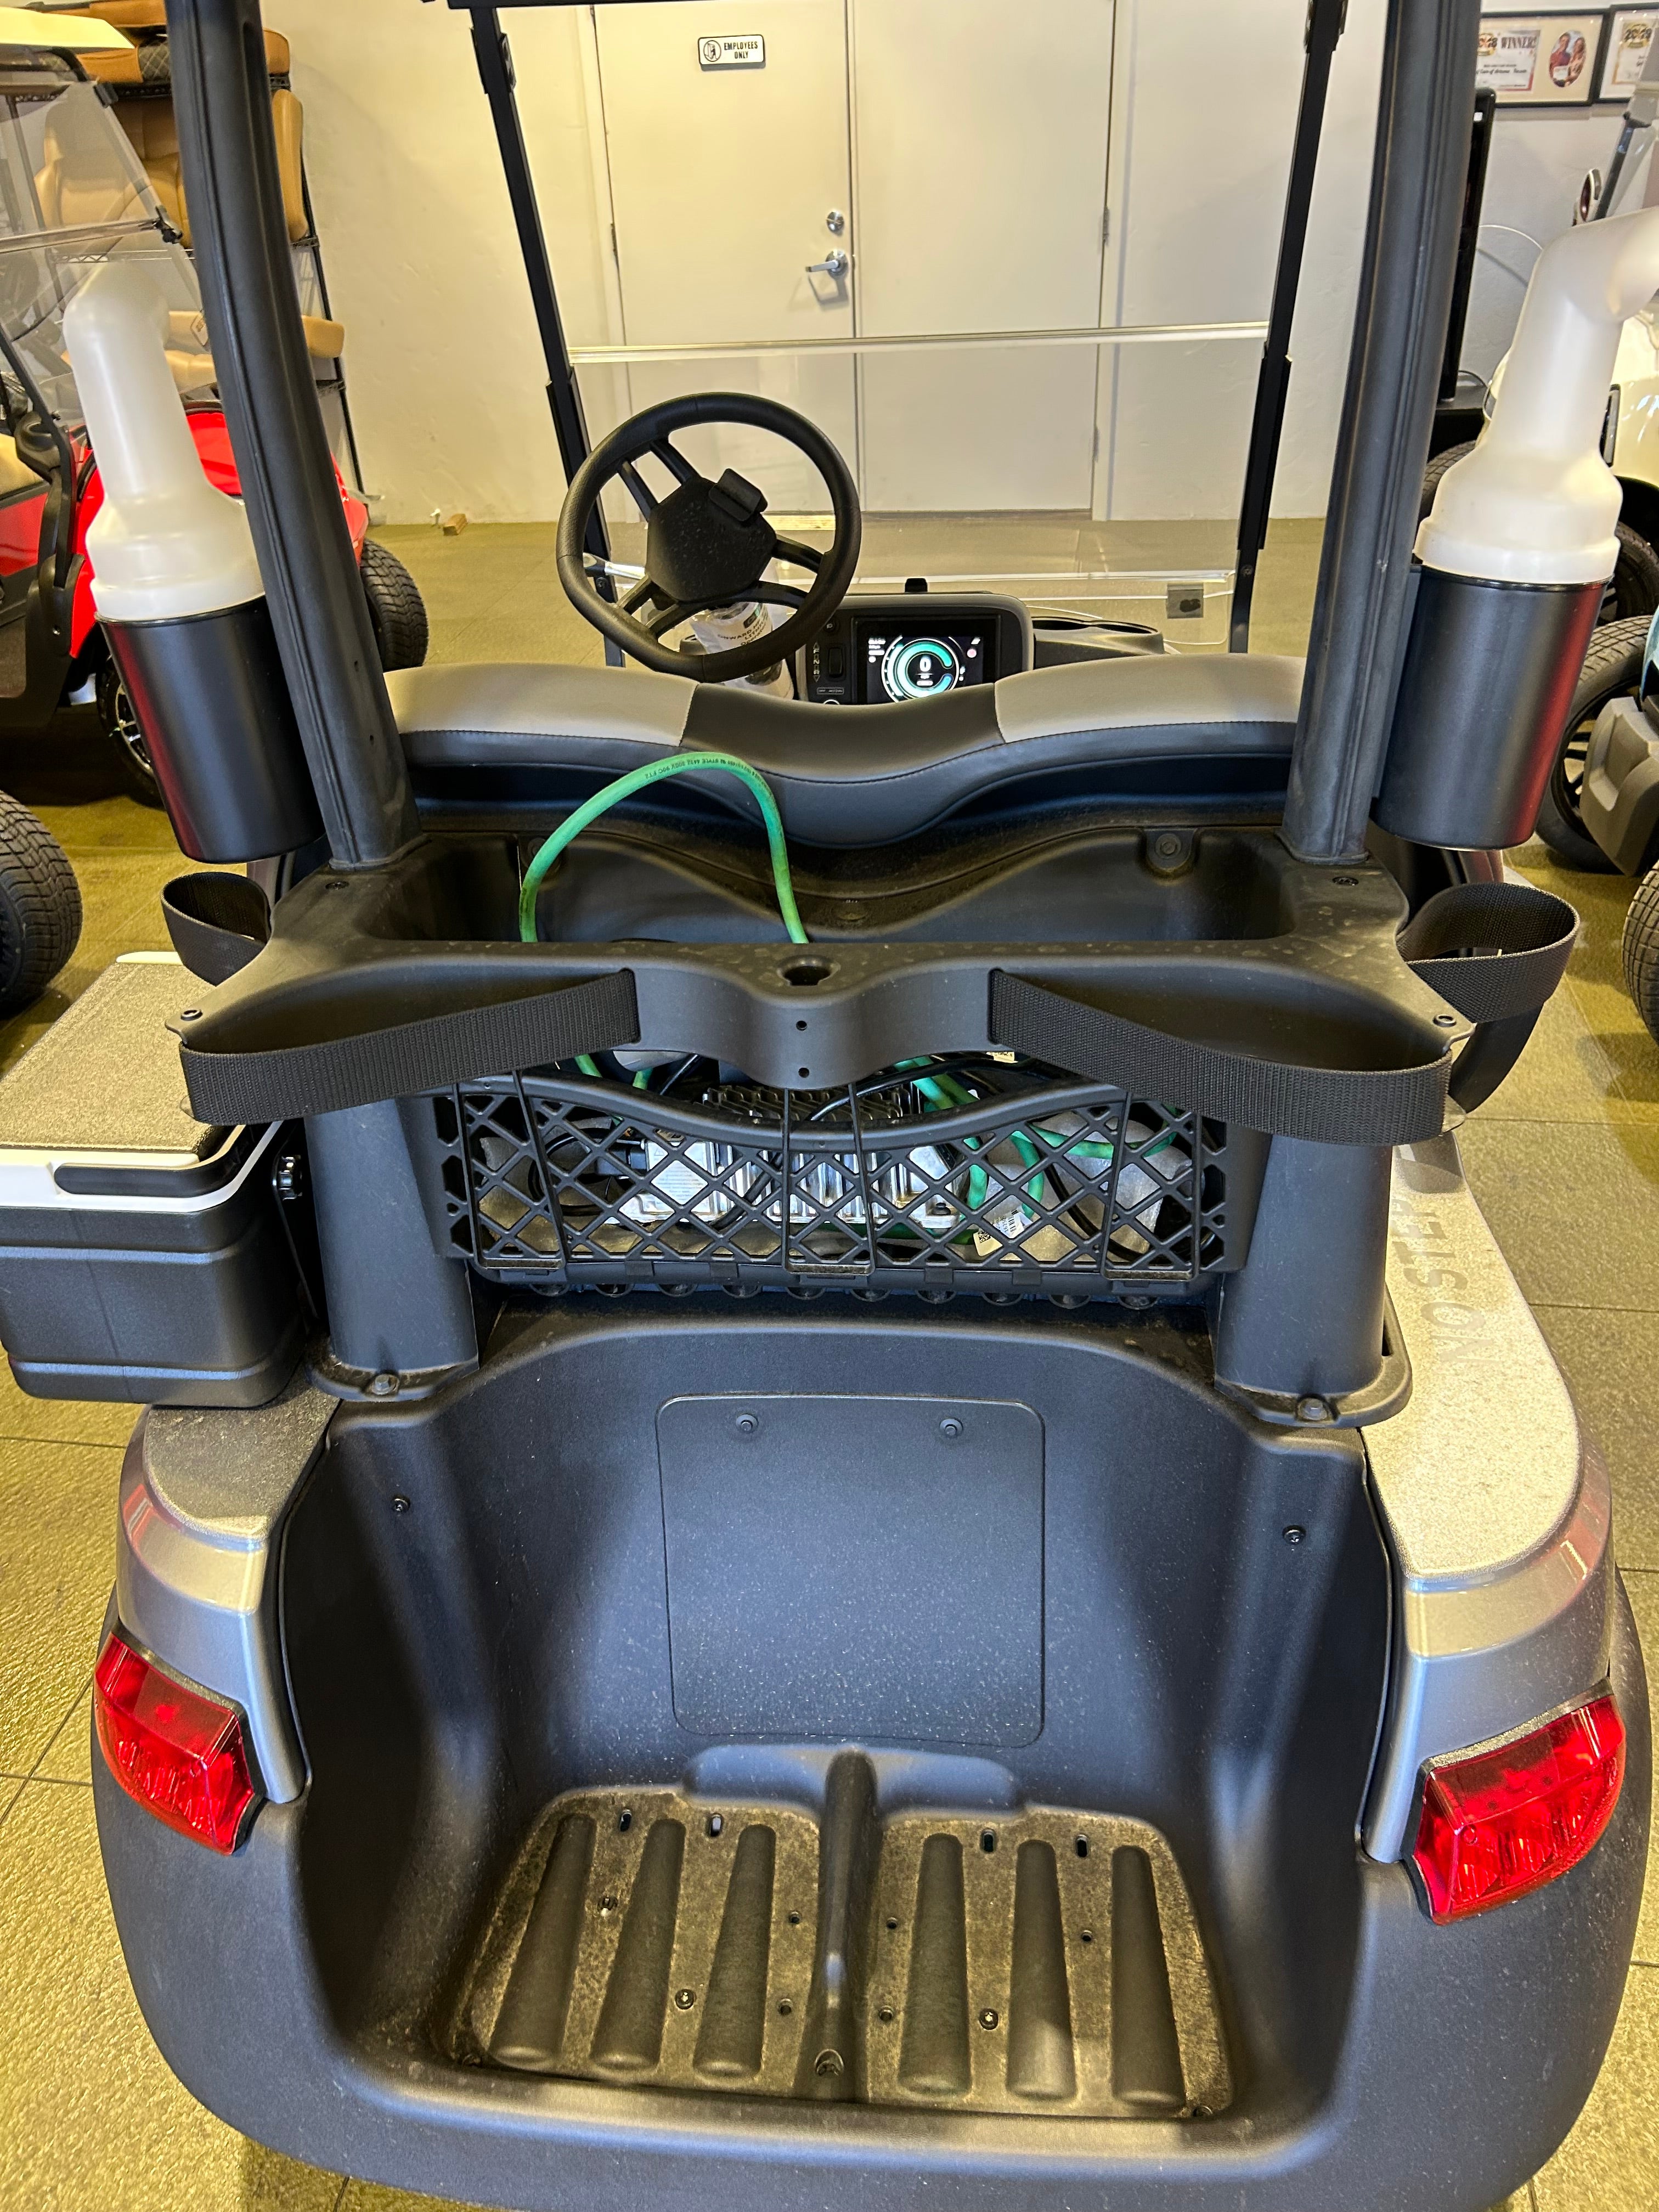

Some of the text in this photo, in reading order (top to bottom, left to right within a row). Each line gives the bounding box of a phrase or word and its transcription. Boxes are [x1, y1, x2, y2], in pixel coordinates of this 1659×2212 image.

[724, 41, 758, 50] EMPLOYEES
[1391, 1199, 1500, 1362] NO STEP
